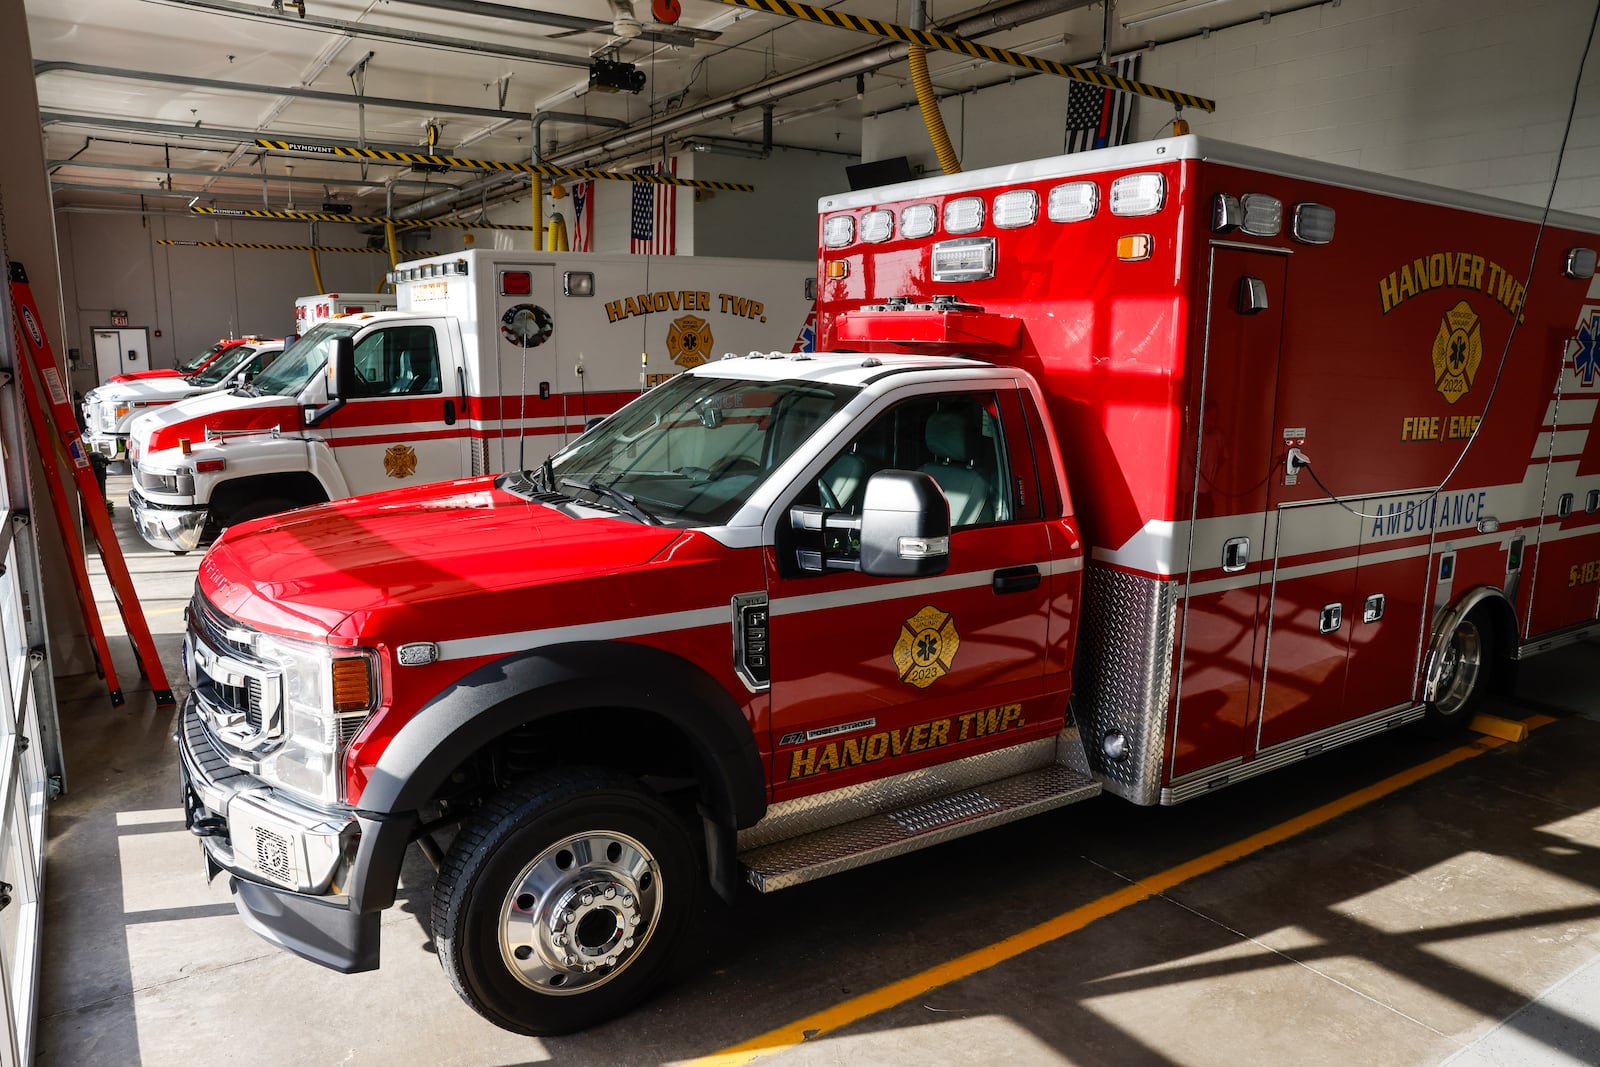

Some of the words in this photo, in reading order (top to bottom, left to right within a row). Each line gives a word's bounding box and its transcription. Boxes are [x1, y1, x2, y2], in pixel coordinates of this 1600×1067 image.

[288, 143, 332, 153] PLYMOVENT
[1378, 251, 1485, 317] HANOVER
[604, 290, 711, 323] HANOVER
[718, 293, 768, 323] TWP.
[682, 356, 699, 364] 2008
[1443, 378, 1463, 393] 2023
[1401, 416, 1440, 442] FIRE
[1448, 415, 1482, 440] EMS
[1371, 492, 1486, 538] AMBULANCE
[911, 667, 938, 682] 2023
[809, 726, 840, 738] POWER
[841, 719, 874, 731] STROKE
[788, 718, 951, 781] HANOVER
[957, 703, 1026, 742] TWP.
